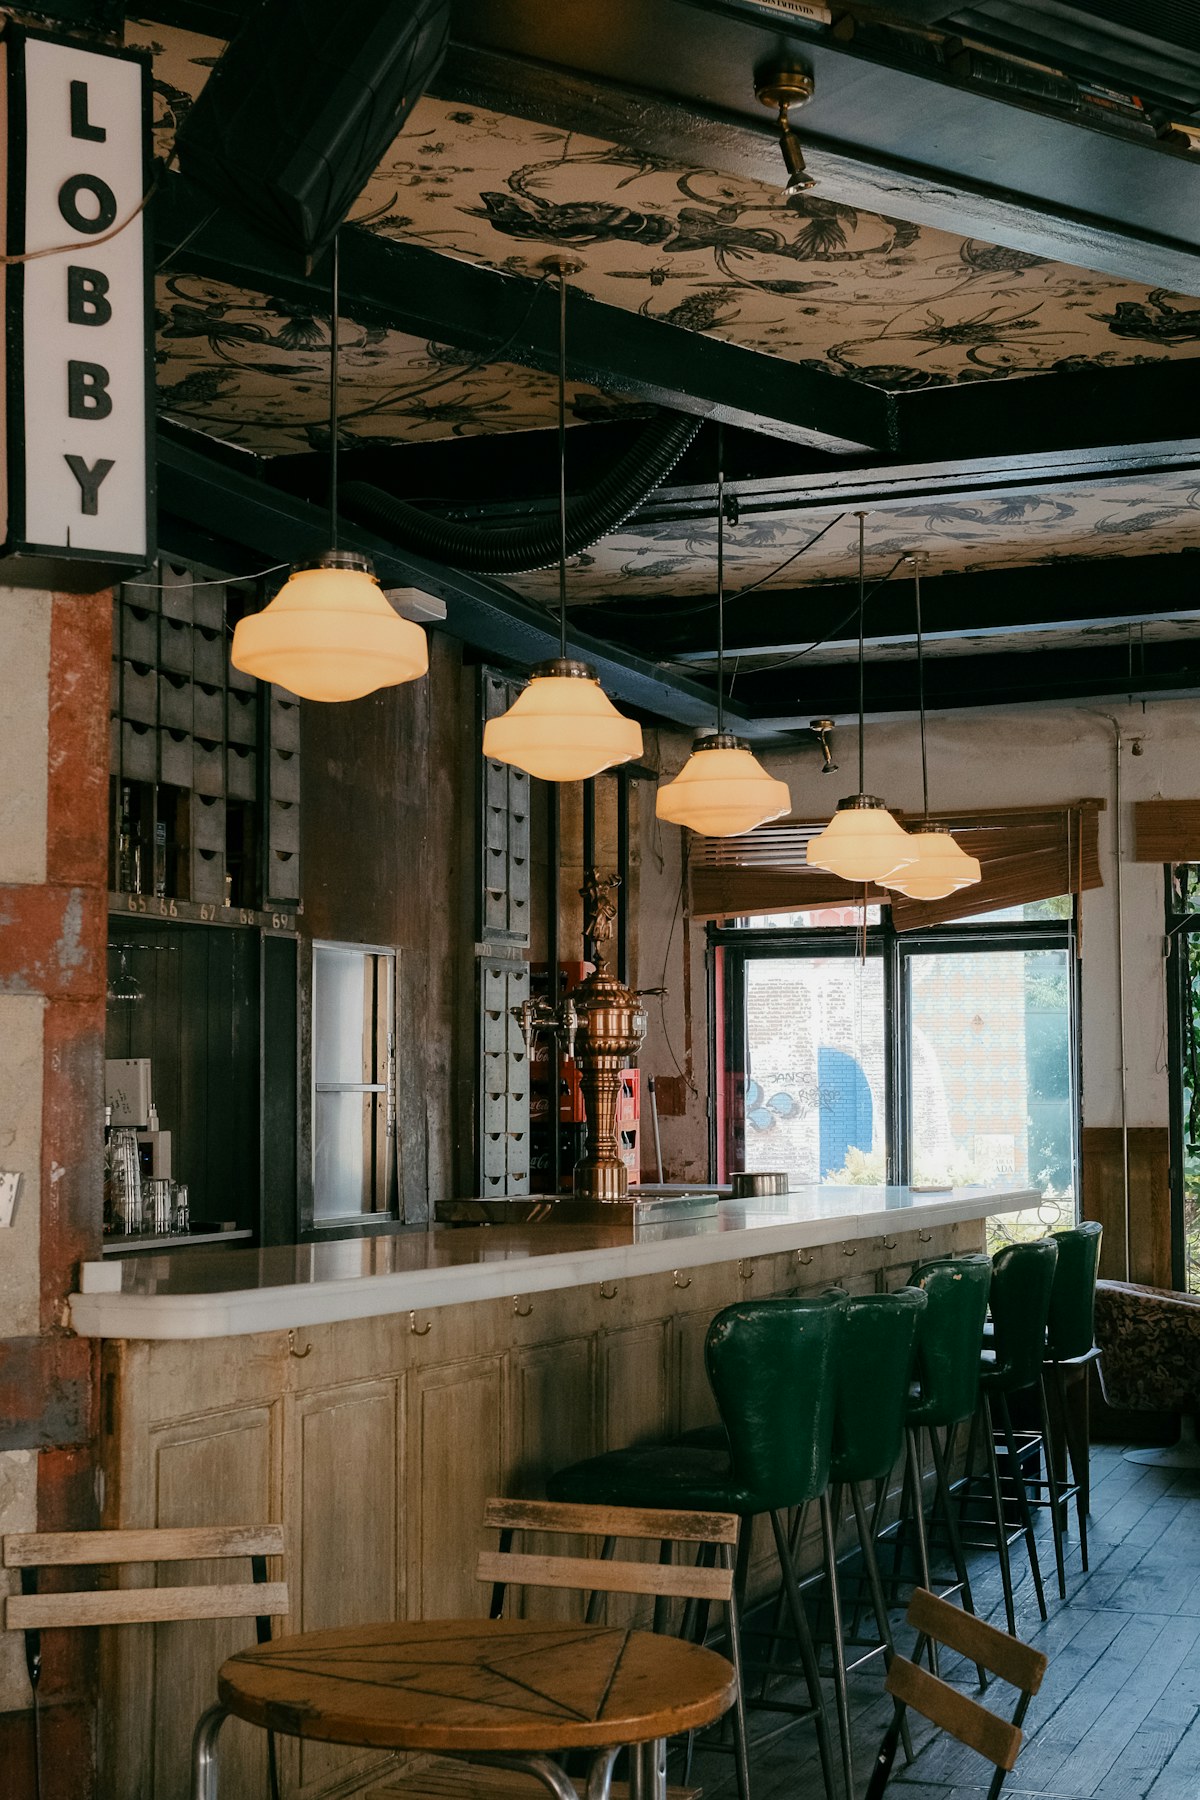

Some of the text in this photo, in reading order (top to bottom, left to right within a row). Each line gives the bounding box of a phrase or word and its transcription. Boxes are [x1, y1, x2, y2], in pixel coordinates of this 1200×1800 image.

[58, 80, 117, 516] LOBBY
[128, 895, 288, 929] 65 66 67 68 69
